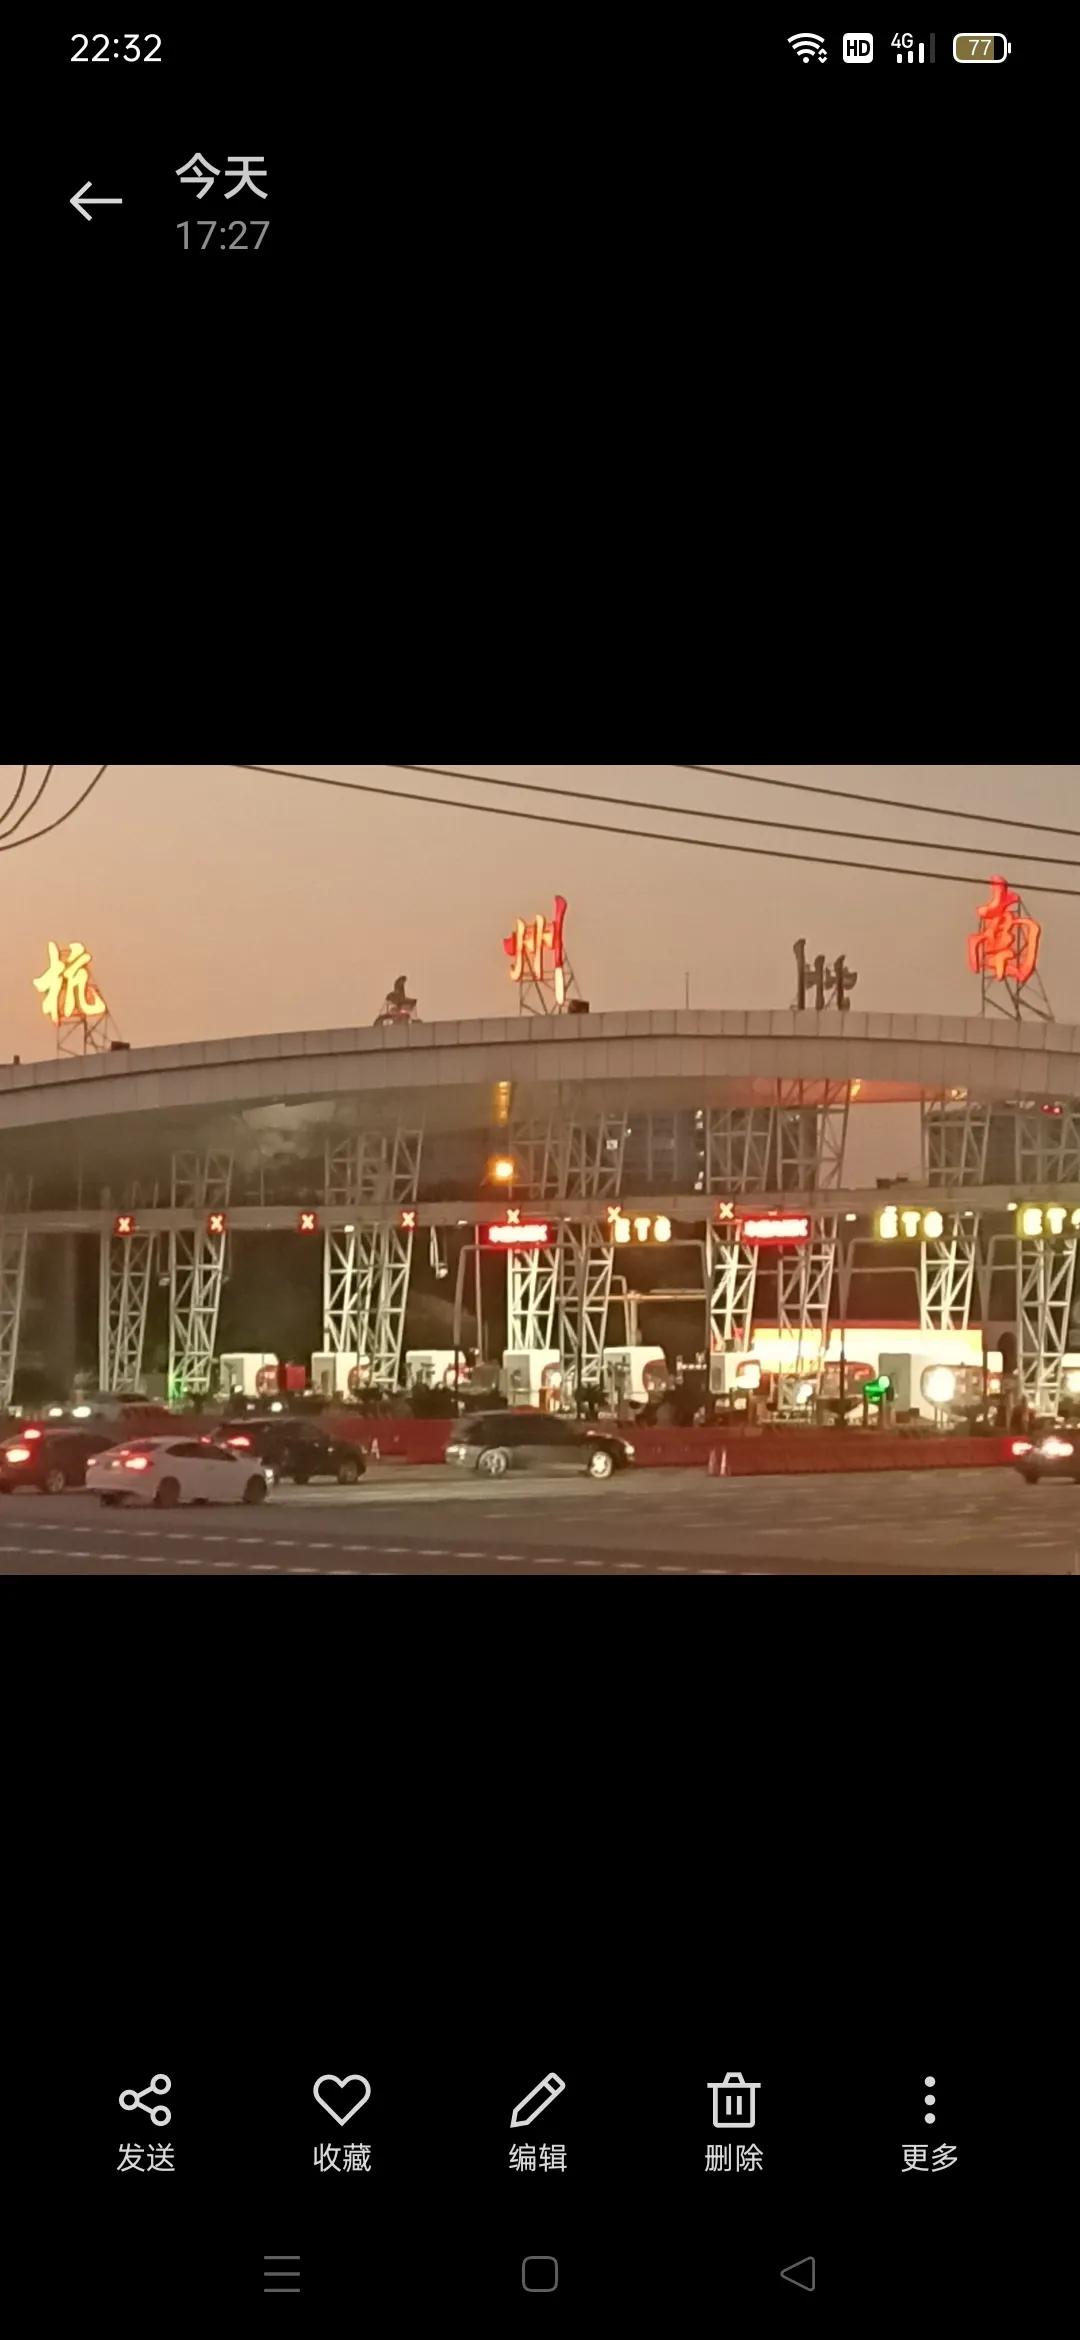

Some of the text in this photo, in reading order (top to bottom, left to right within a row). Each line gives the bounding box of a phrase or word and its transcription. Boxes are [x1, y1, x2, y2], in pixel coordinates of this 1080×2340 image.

[33, 875, 1041, 1025] 杭 州 南
